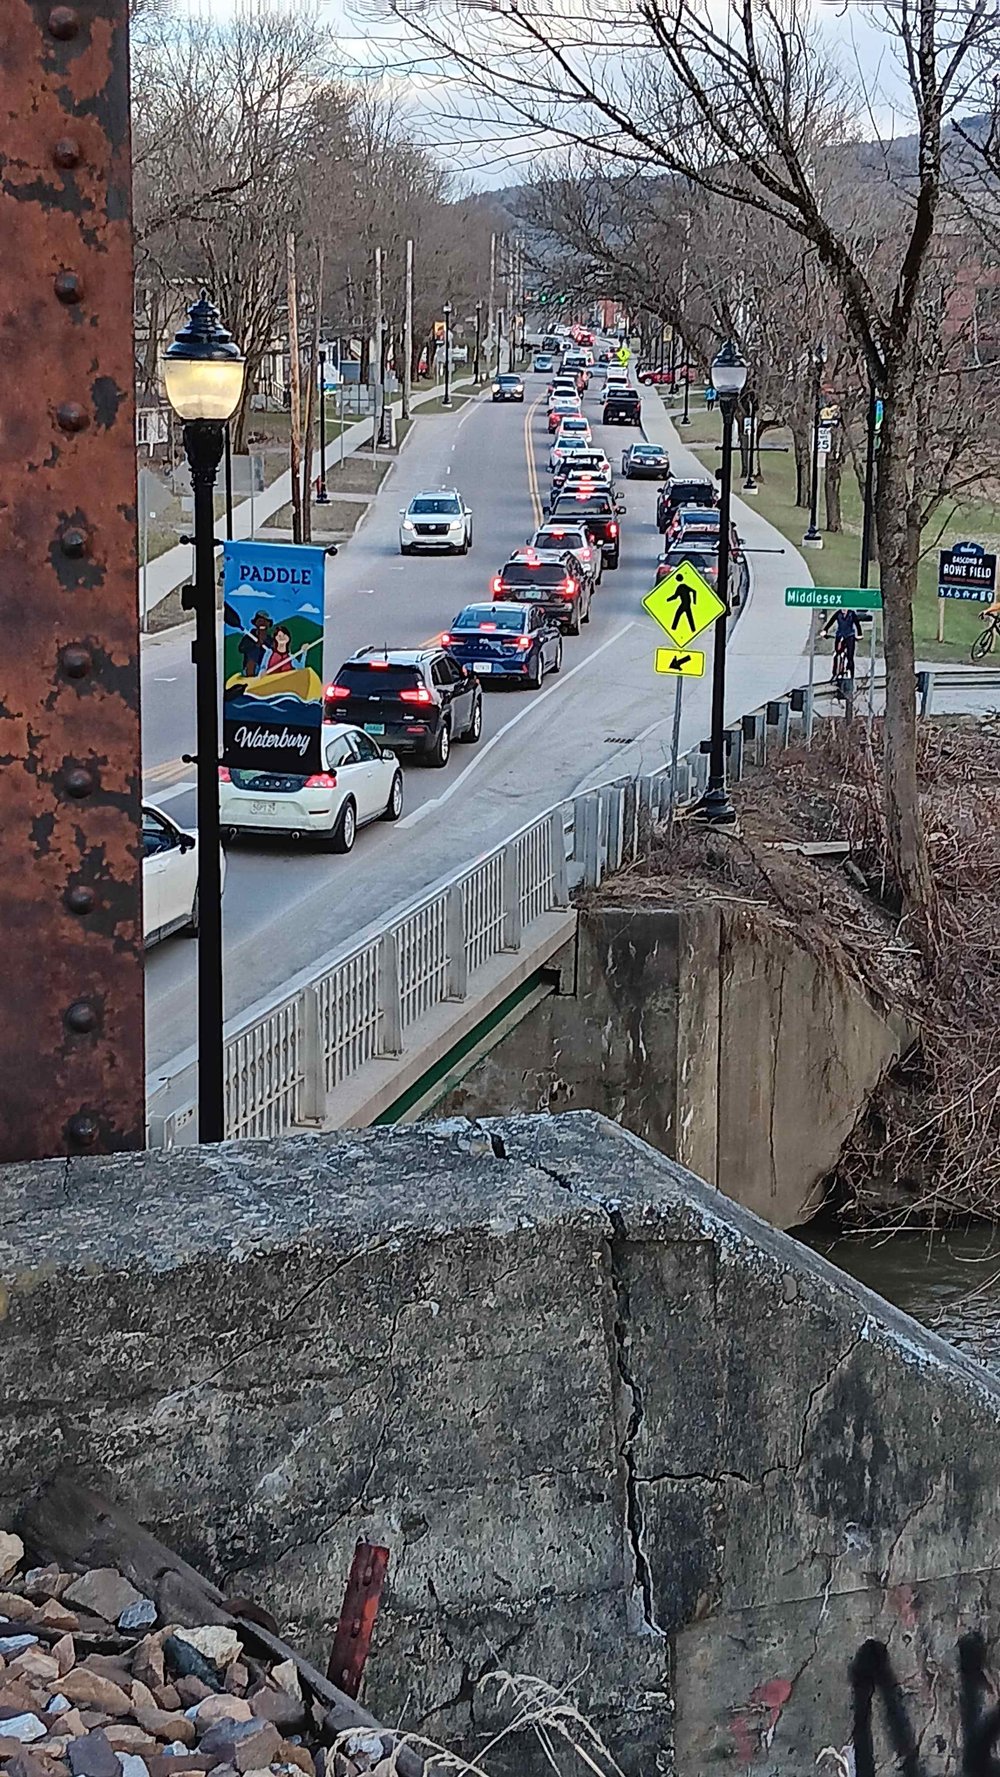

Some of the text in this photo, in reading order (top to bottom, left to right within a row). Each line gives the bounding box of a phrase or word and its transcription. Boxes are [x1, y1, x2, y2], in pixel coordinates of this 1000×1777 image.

[240, 565, 311, 585] PADDLE
[970, 566, 992, 579] FIELD
[787, 590, 842, 604] Middlesex
[234, 726, 311, 756] Waterbury
